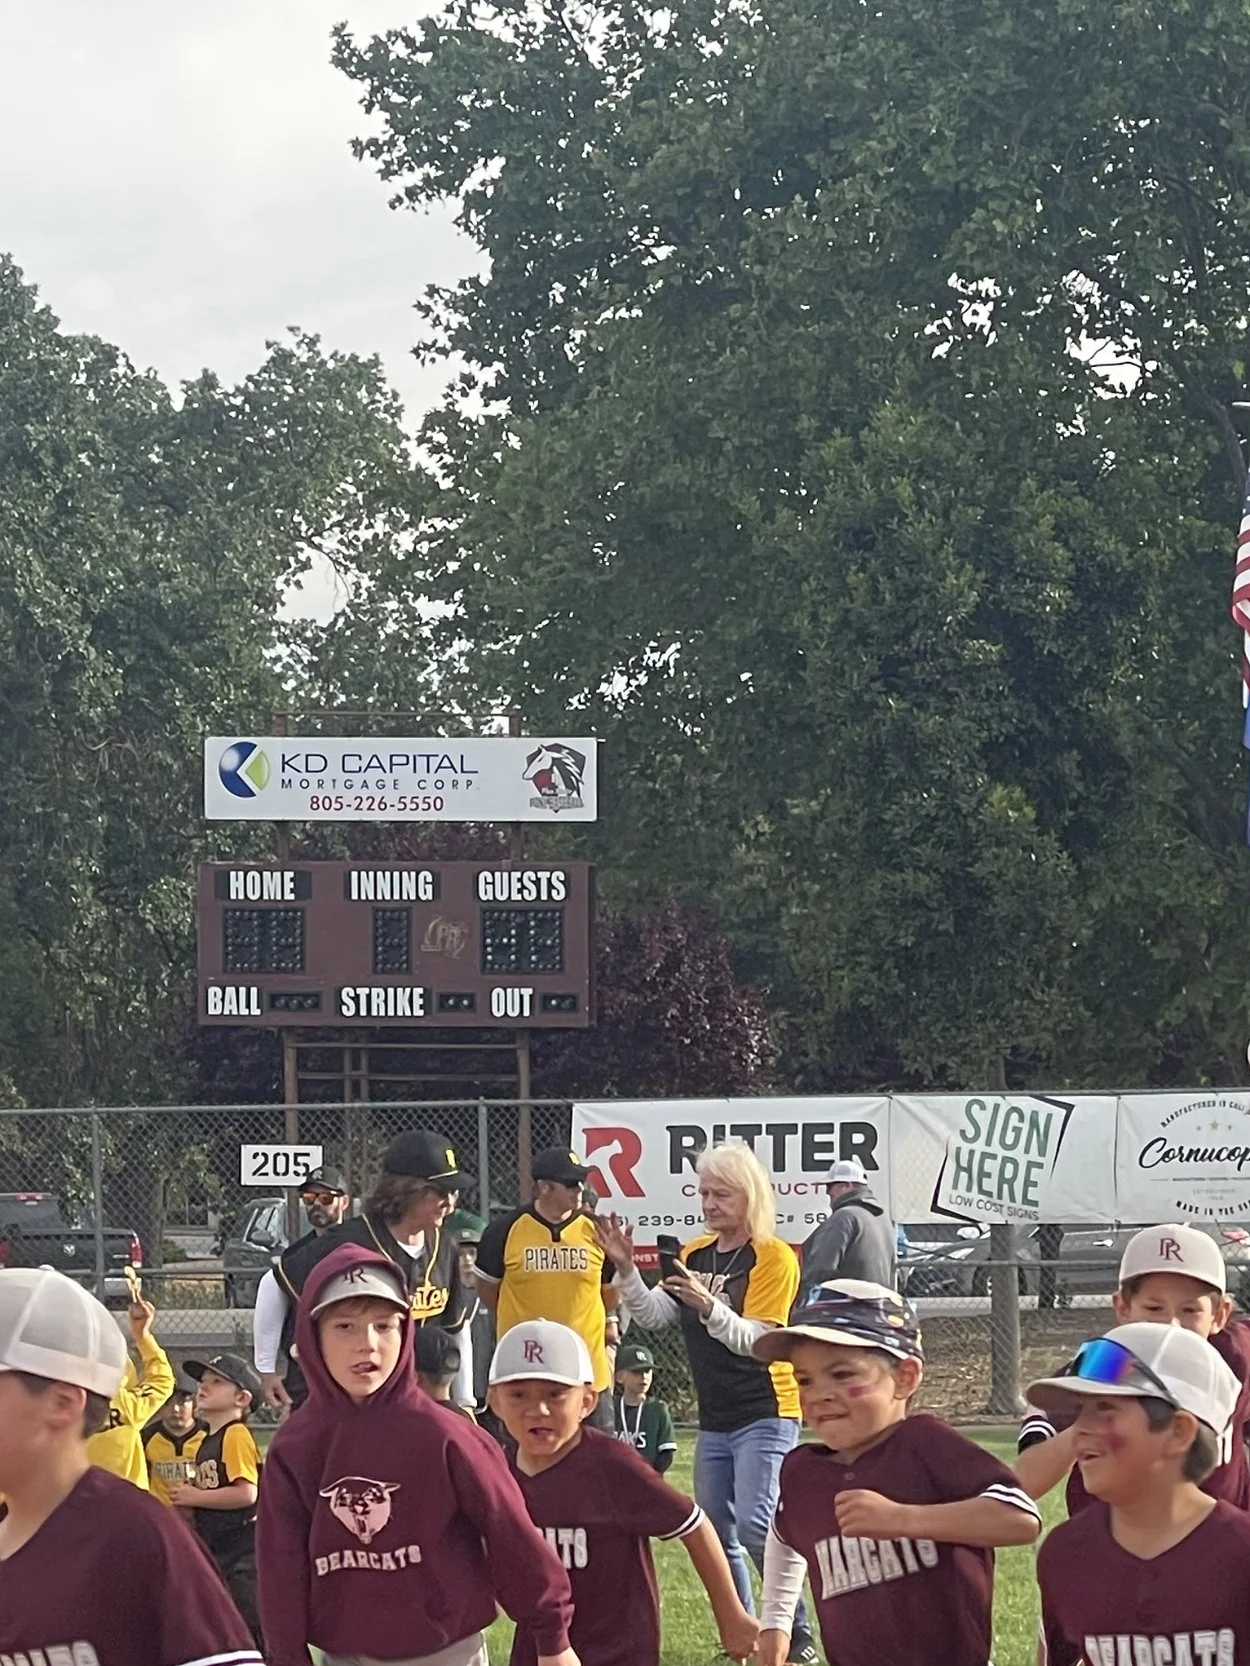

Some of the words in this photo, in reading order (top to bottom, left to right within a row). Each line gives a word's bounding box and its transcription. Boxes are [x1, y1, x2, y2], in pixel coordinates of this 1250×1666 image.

[281, 753, 328, 774] KD
[341, 753, 478, 774] CAPITAL
[281, 779, 399, 790] MORTGAGE
[309, 796, 445, 812] 805-226-5550
[229, 871, 295, 900] HOME
[351, 871, 433, 900] INNING
[478, 871, 566, 900] GUESTS
[207, 986, 261, 1016] BALL
[341, 987, 424, 1017] STRIKE
[490, 987, 533, 1017] OUT
[960, 1098, 1053, 1158] SIGN
[251, 1152, 311, 1177] 205
[952, 1146, 1044, 1207] HERE
[949, 1194, 973, 1208] LOW
[976, 1196, 1005, 1213] COST
[1007, 1205, 1040, 1221] SIGNS
[1176, 1200, 1199, 1215] MADE
[524, 1246, 588, 1272] PIRATES
[315, 1545, 422, 1576] BEARCATS
